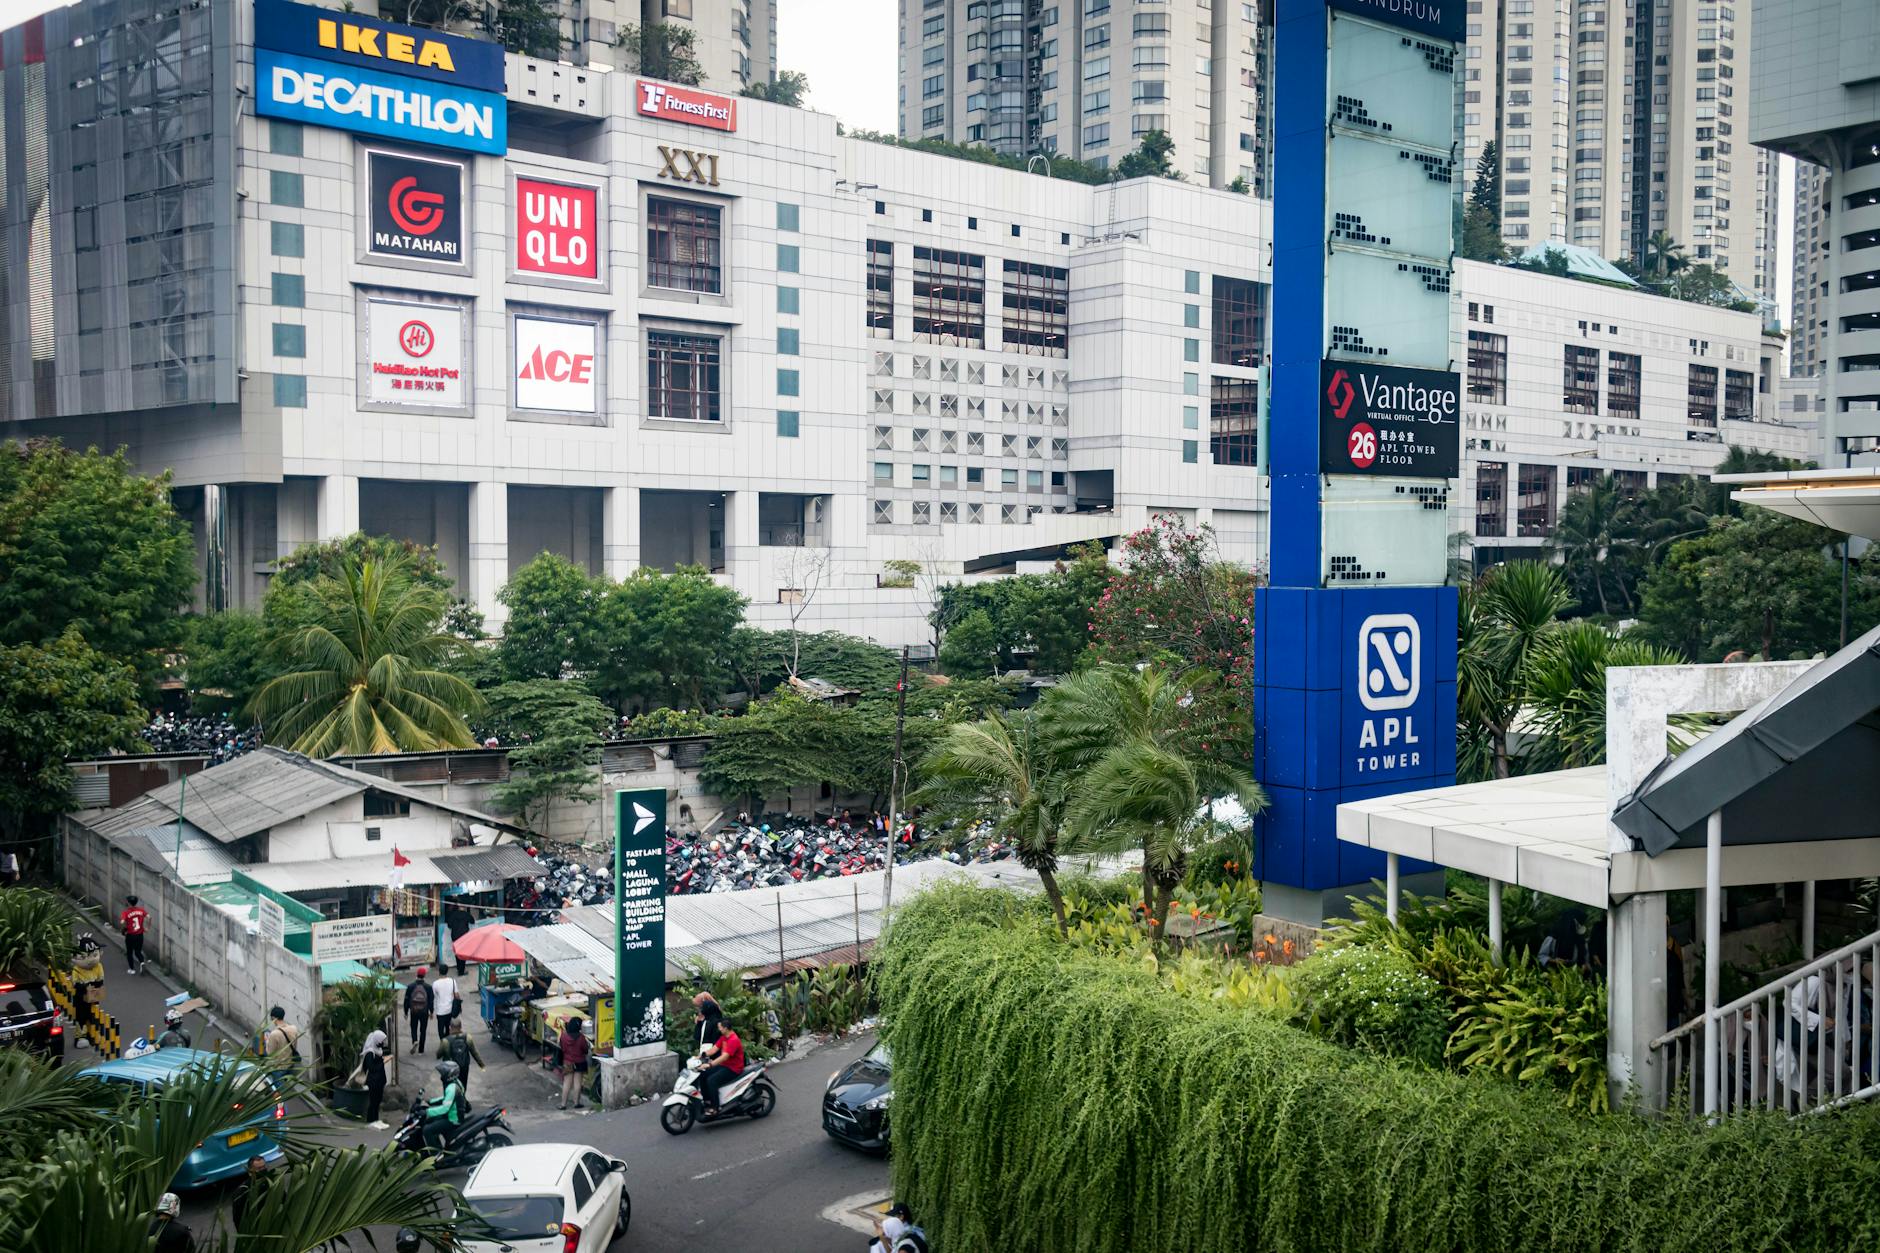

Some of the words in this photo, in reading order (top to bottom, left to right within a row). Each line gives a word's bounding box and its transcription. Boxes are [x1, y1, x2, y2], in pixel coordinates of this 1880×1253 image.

[319, 18, 455, 72] IKEA
[272, 66, 493, 140] DECATHLON
[657, 146, 720, 186] XXI
[525, 192, 582, 230] UNI
[375, 232, 457, 255] MATAHARI
[525, 230, 588, 267] QLO
[407, 326, 427, 349] Hi
[519, 344, 594, 384] ACE
[420, 365, 440, 378] Hot
[440, 367, 459, 380] Pot
[1360, 373, 1456, 424] Vantage
[1367, 412, 1393, 421] VIRTUAL
[1393, 413, 1415, 422] OFFICE
[1350, 431, 1375, 460] 26
[1380, 443, 1398, 453] APL
[1402, 444, 1436, 455] TOWER
[1380, 454, 1413, 465] FLOOR
[1359, 716, 1419, 748] APL
[1357, 752, 1420, 772] TOWER
[625, 850, 643, 859] FAST
[643, 848, 662, 857] LANE
[625, 859, 637, 867] TO
[626, 869, 648, 879] MALL
[625, 877, 660, 888] LAGUNA
[625, 887, 653, 897] LOBBY
[626, 898, 662, 909] PARKING
[625, 906, 664, 917] BUILDING
[626, 917, 637, 925] VIA
[637, 915, 664, 924] EXPRESS
[625, 923, 644, 932] RAMP
[626, 932, 640, 941] APL
[625, 940, 652, 950] TOWER
[495, 963, 517, 974] Grab
